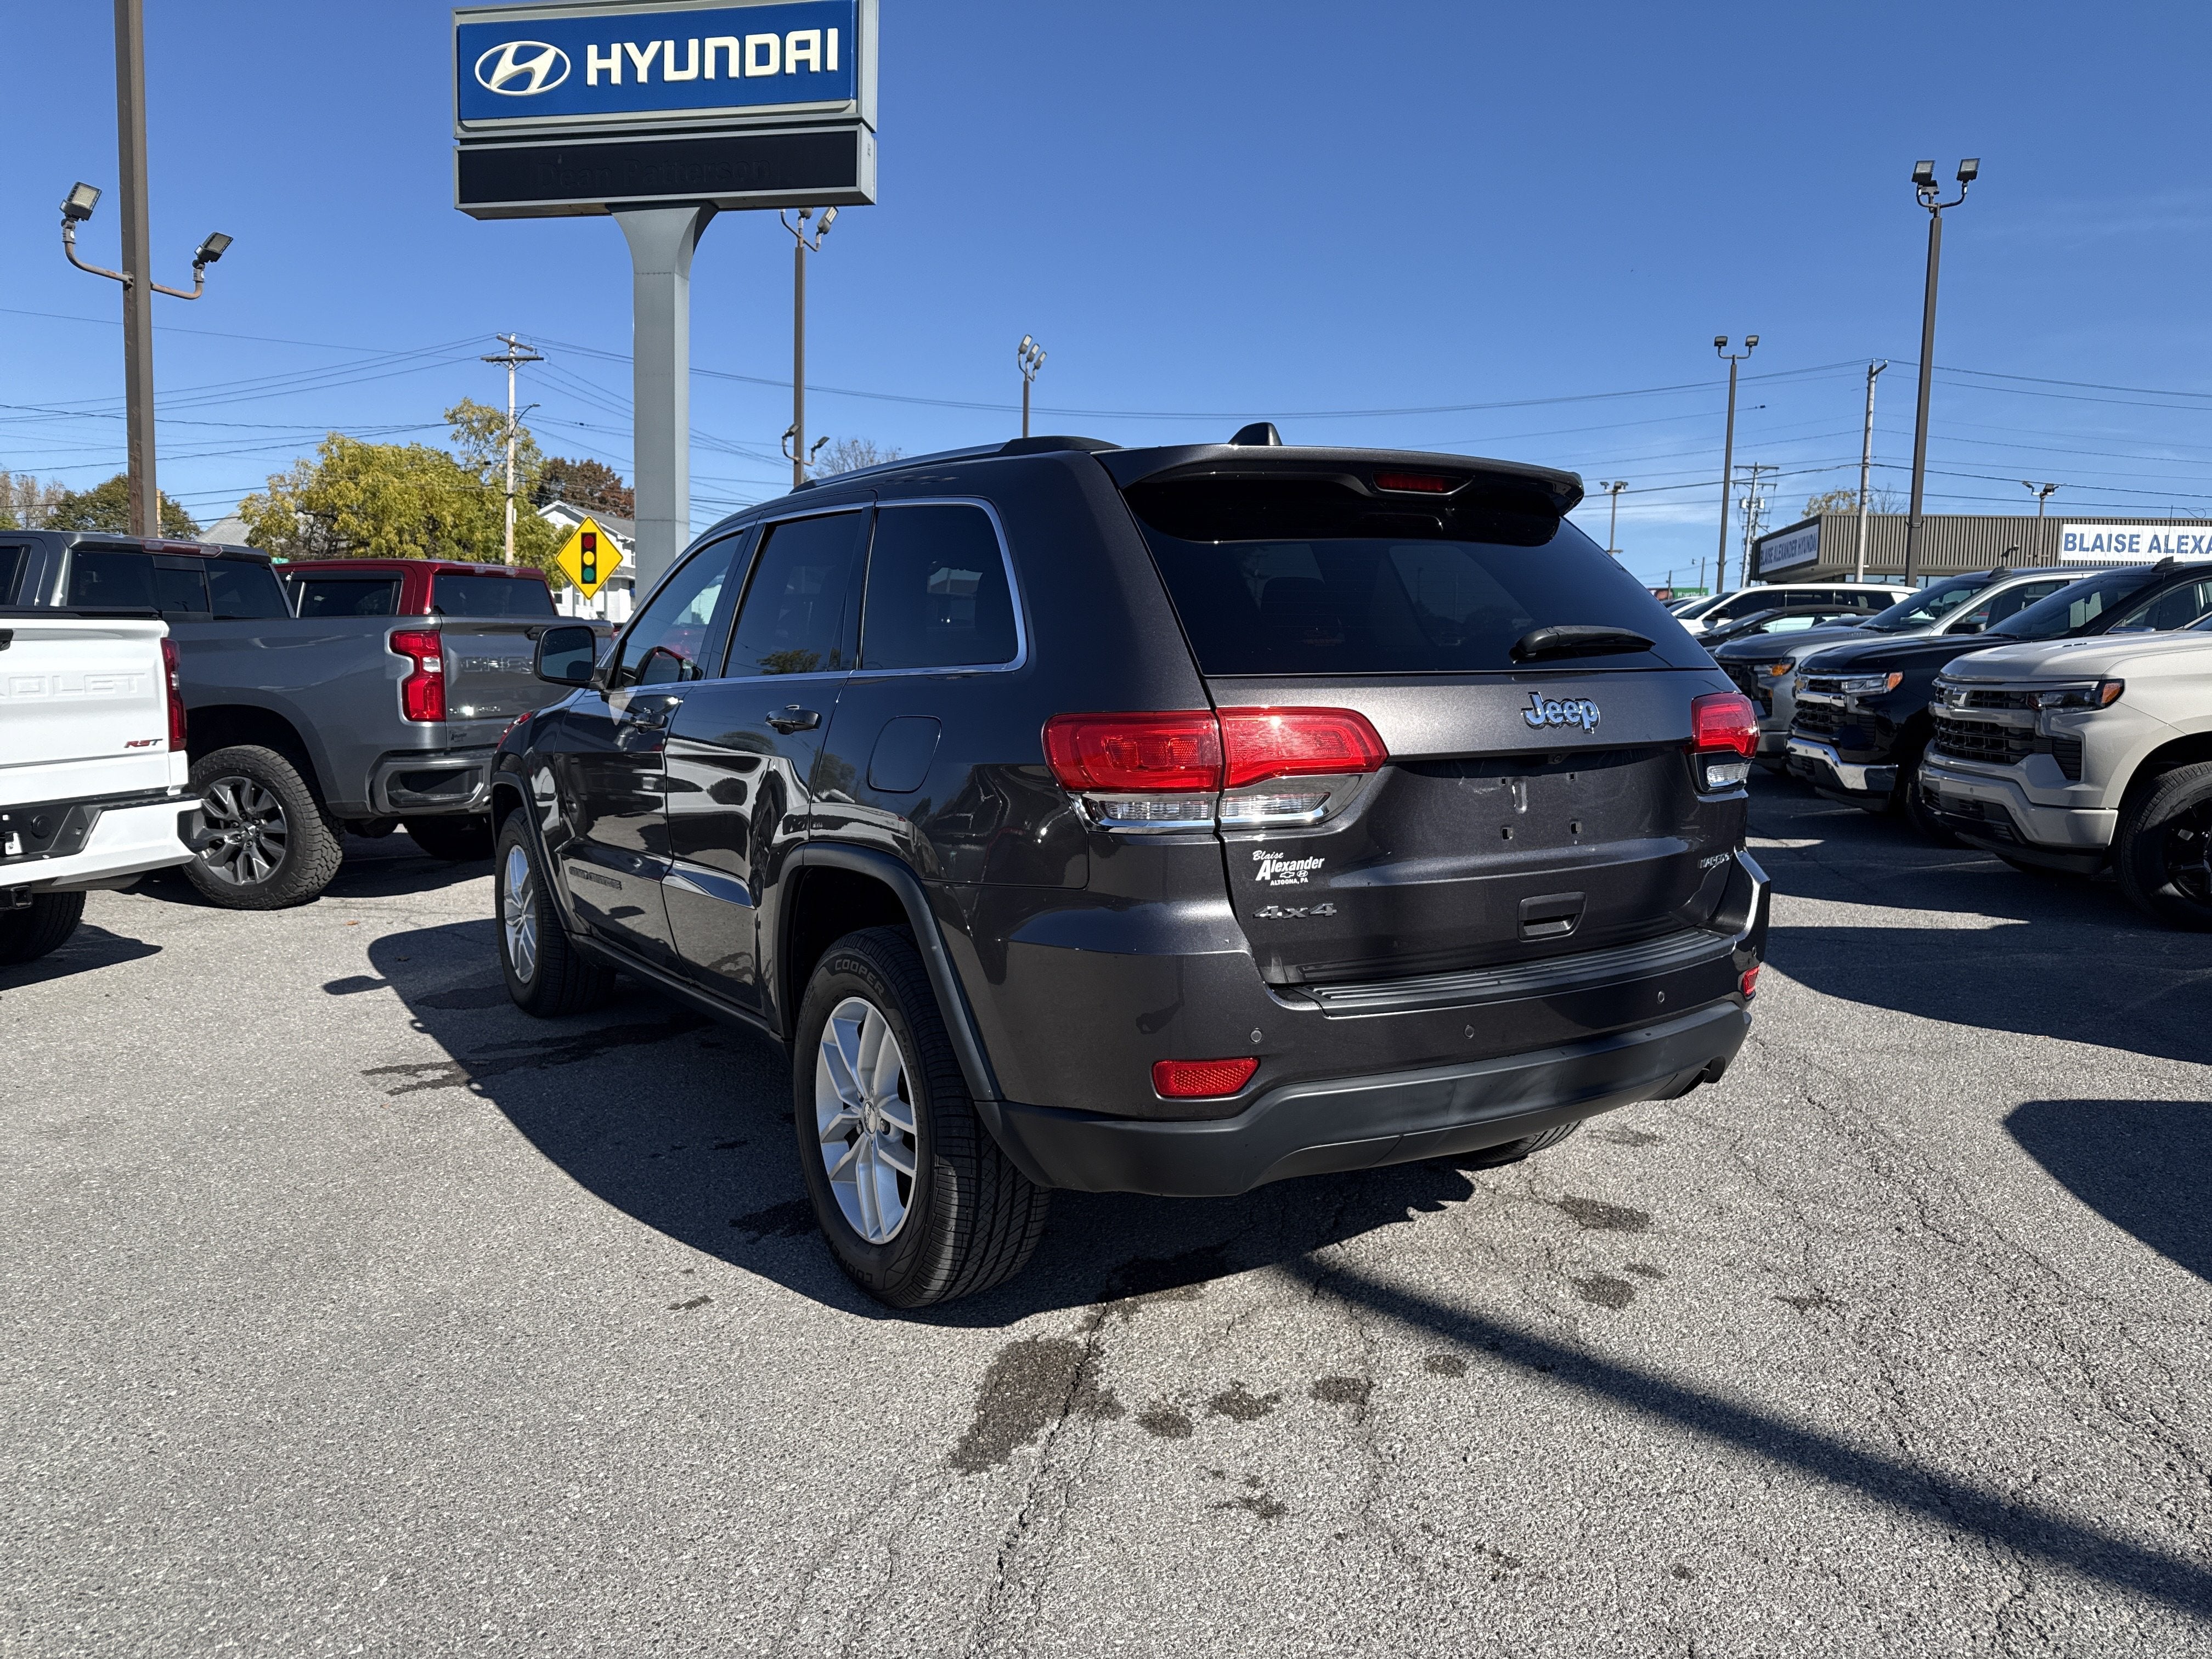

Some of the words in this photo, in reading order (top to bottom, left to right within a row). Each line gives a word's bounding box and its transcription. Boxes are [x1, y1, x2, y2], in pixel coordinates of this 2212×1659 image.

[586, 27, 838, 86] HYUNDAI
[537, 162, 613, 191] Dean
[623, 156, 772, 188] Patterson
[2063, 533, 2141, 553] BLAISE
[1521, 691, 1600, 733] Jeep
[123, 738, 163, 748] RST
[1252, 850, 1284, 860] Blaise
[1255, 856, 1325, 881] Alexander
[834, 958, 885, 997] COOPER
